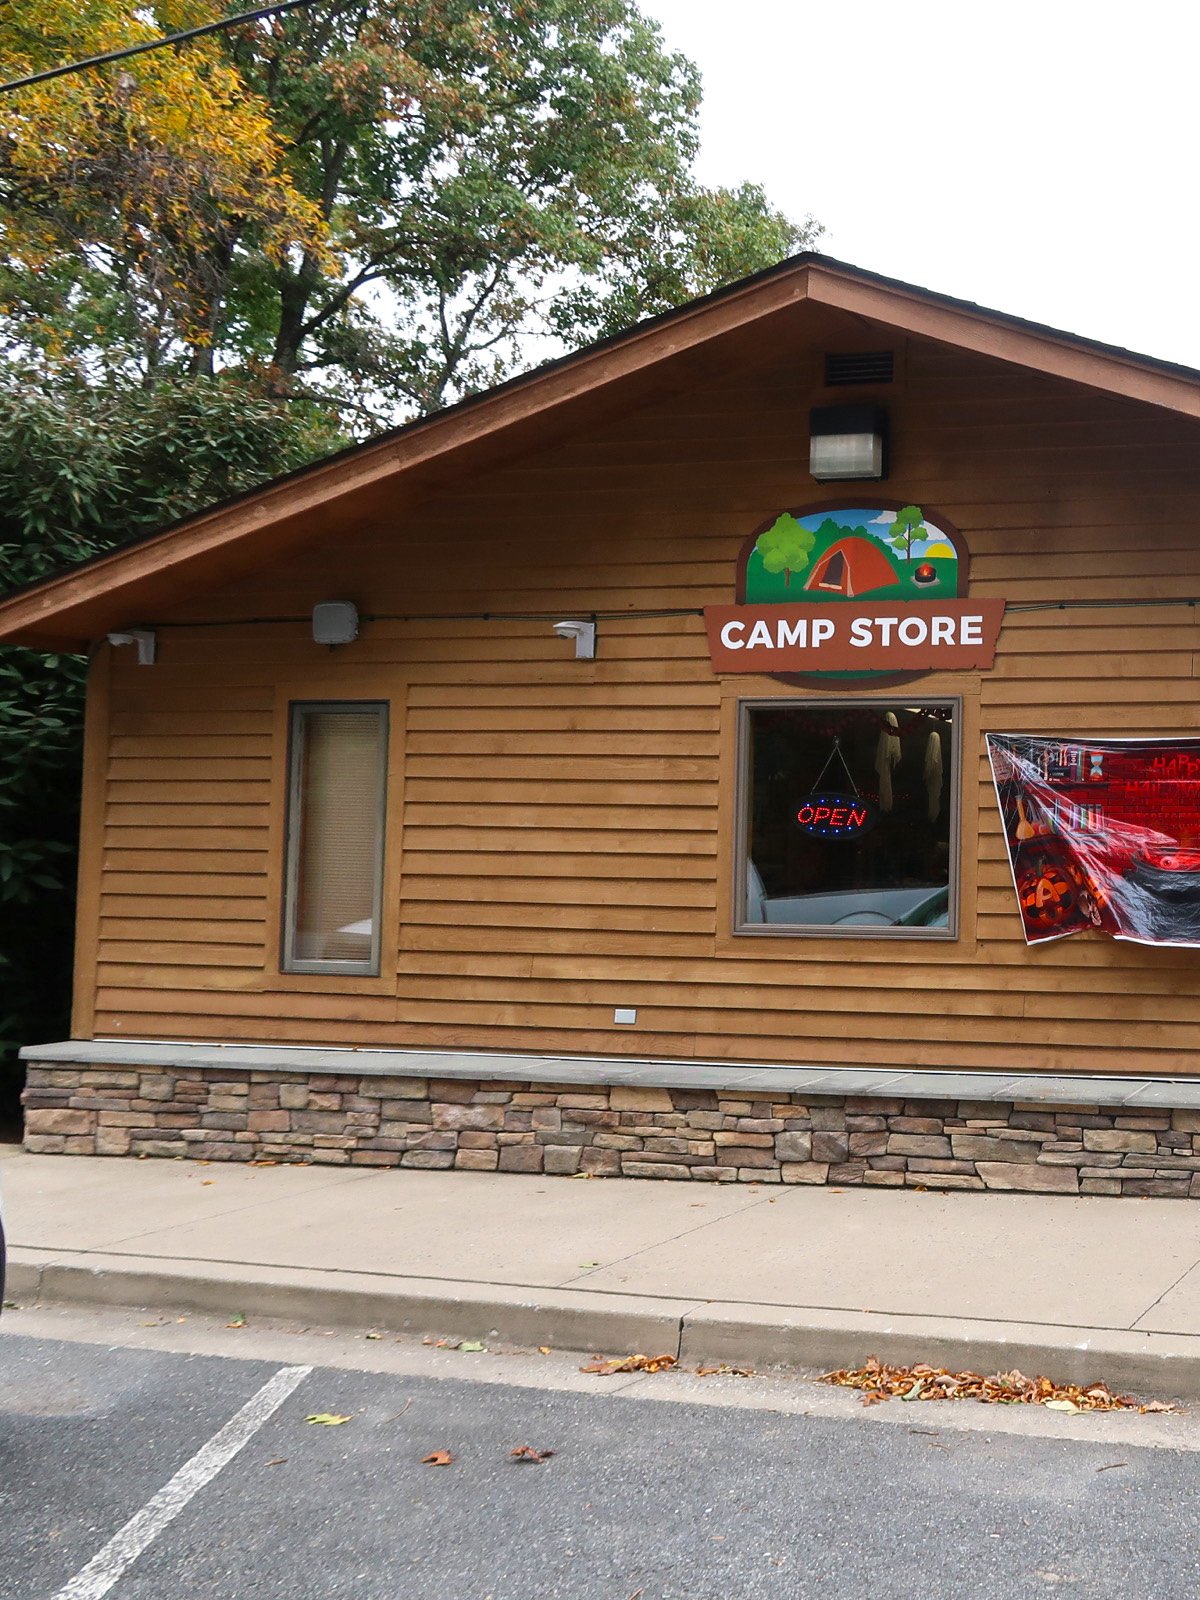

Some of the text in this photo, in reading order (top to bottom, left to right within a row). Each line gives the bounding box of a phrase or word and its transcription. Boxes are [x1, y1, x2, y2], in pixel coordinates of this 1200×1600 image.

[720, 615, 983, 650] CAMP STORE
[797, 806, 867, 827] OPEN
